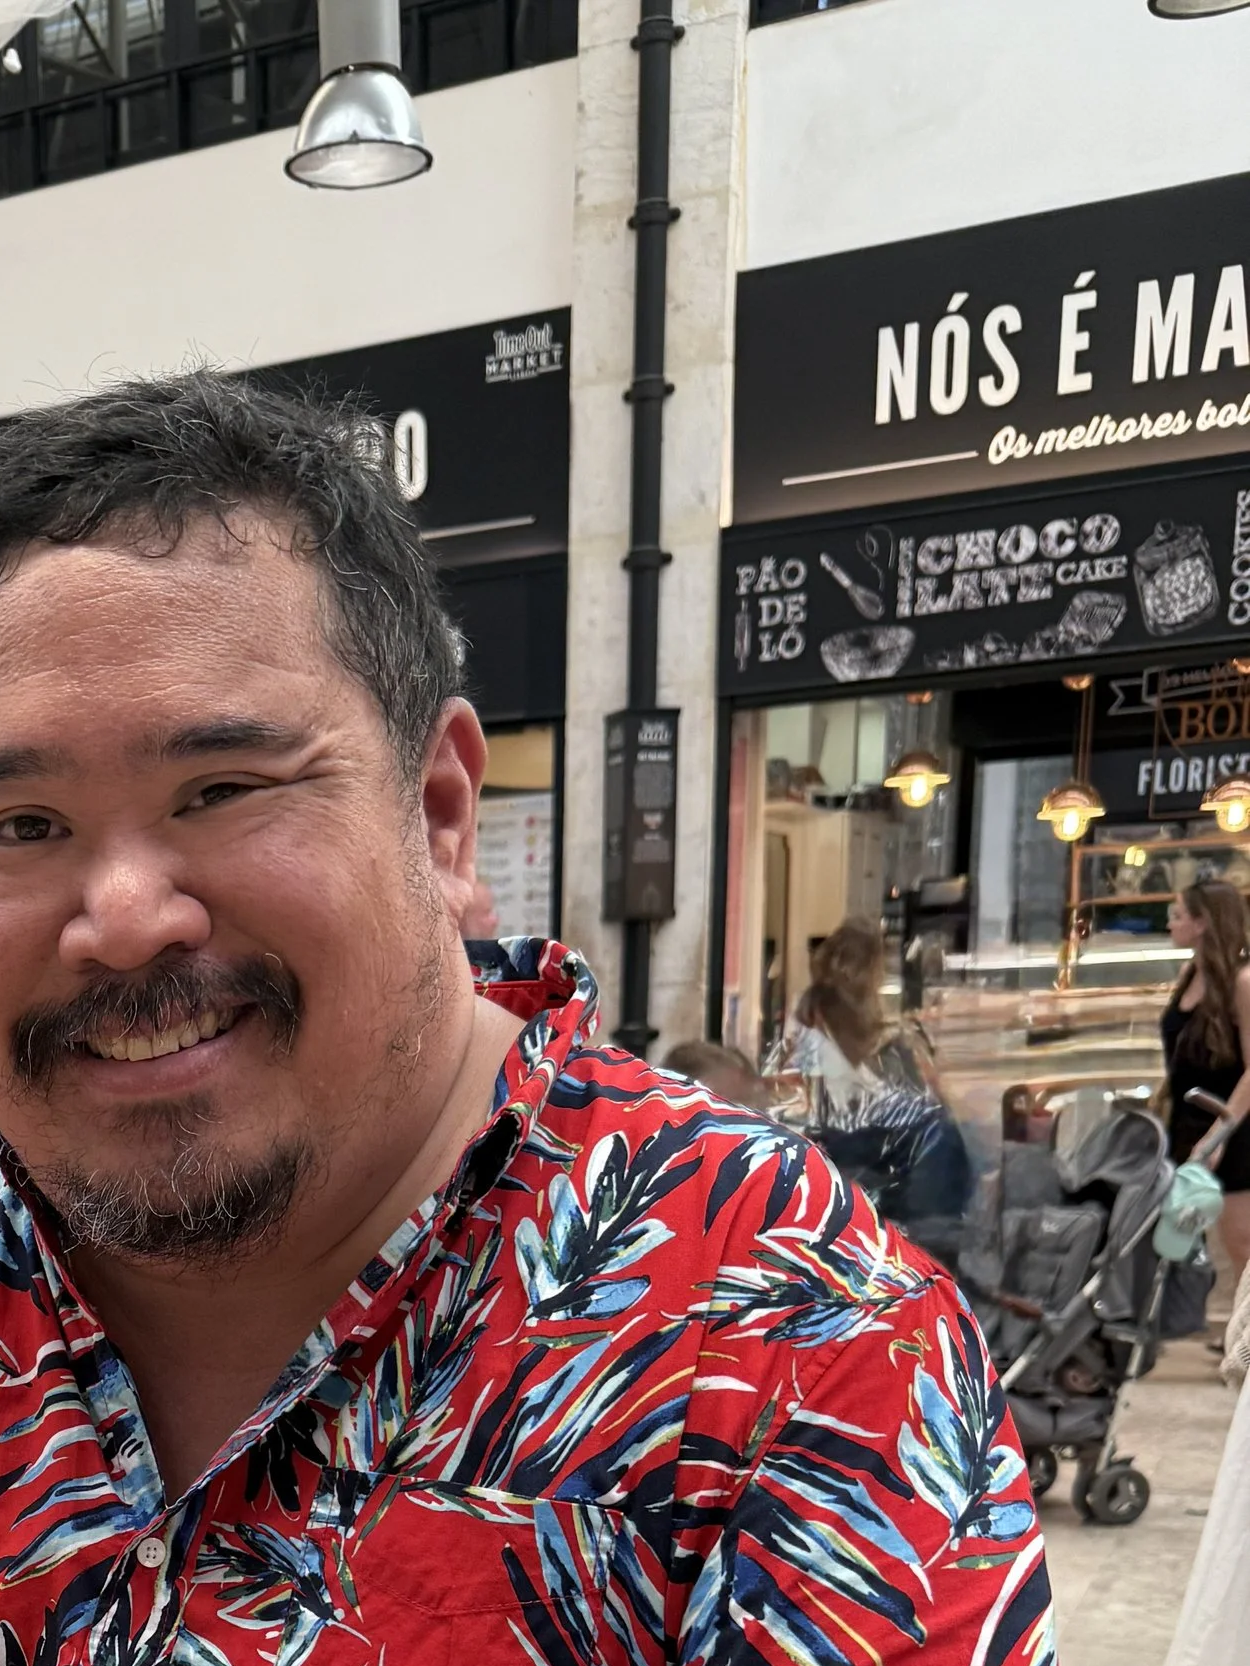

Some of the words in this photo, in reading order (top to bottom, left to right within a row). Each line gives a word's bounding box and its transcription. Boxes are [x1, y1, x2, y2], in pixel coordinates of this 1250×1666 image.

[875, 292, 1022, 425] NÓS
[1057, 270, 1097, 395] É
[1132, 264, 1250, 384] MA
[988, 425, 1033, 465] Os
[1033, 410, 1193, 456] melhores
[917, 513, 1121, 575] CHOCO
[758, 593, 807, 628] DE
[914, 561, 1054, 617] LATE
[1056, 554, 1128, 585] CAKE
